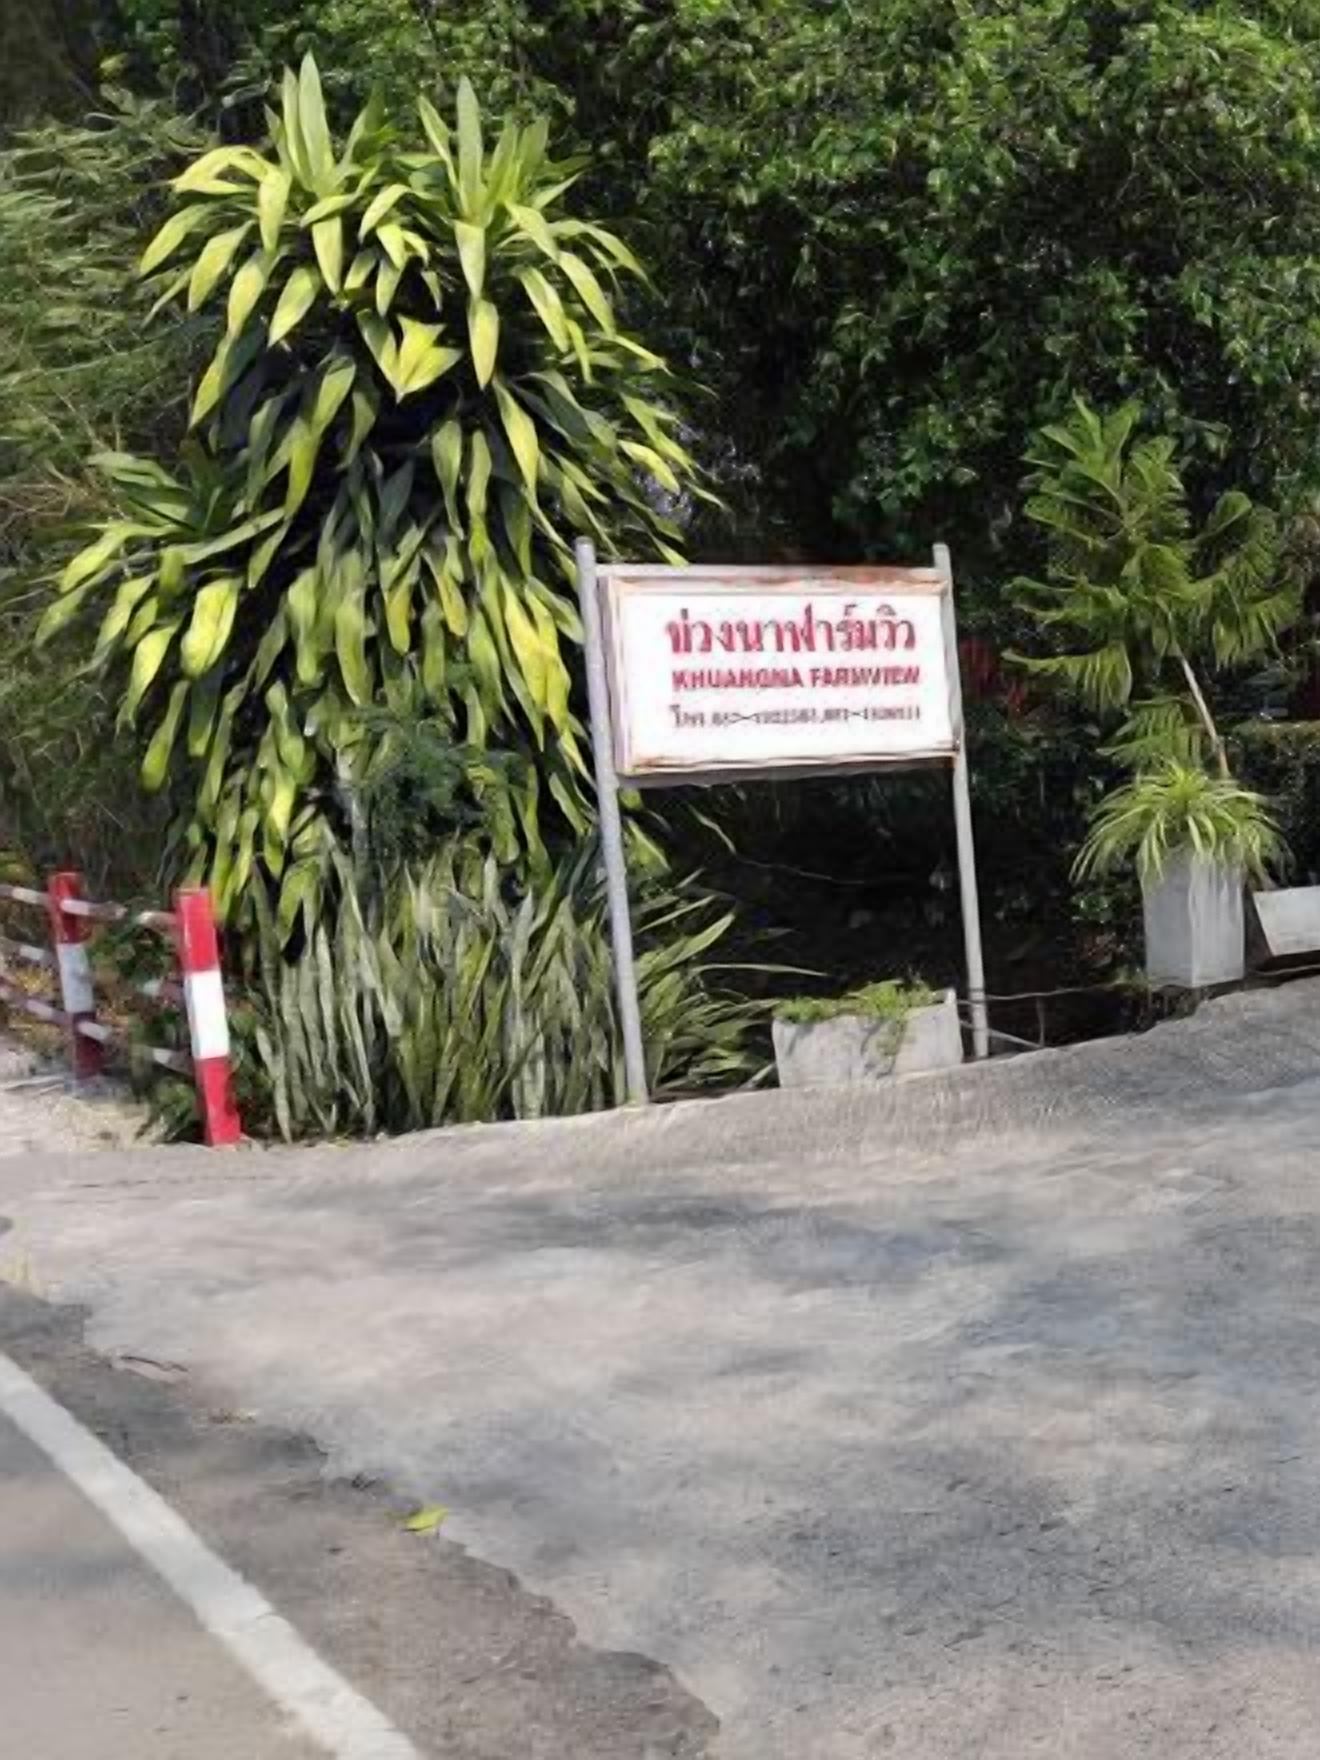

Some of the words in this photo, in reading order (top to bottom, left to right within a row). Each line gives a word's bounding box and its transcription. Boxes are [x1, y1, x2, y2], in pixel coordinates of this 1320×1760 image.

[665, 603, 916, 653] ข่วงนาฟาร์มวิว
